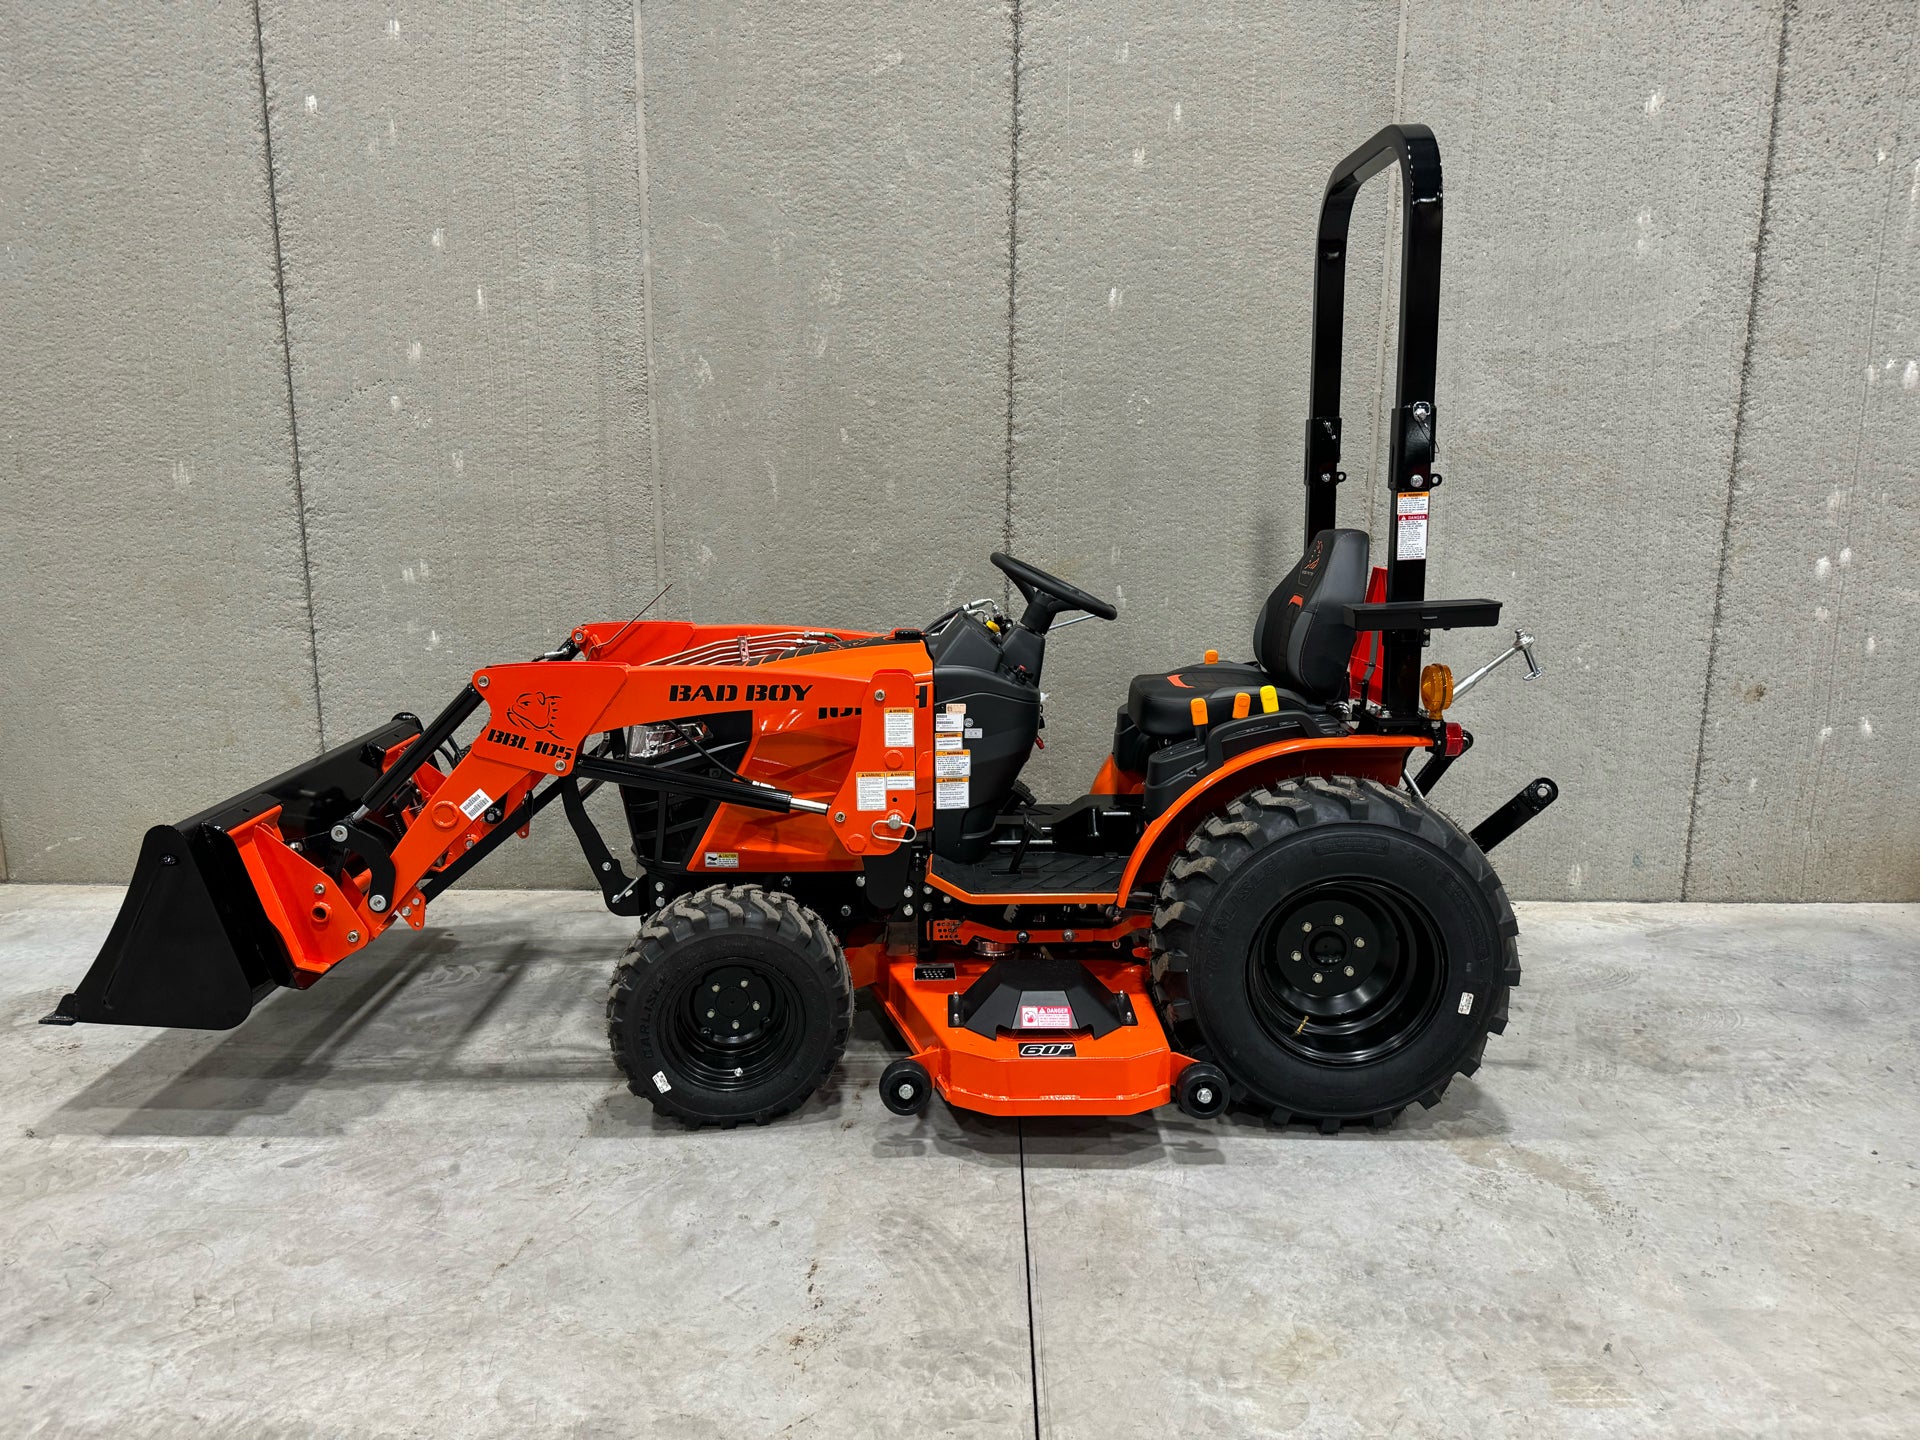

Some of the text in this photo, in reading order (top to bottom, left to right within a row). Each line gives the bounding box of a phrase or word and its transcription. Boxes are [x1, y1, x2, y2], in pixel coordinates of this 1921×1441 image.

[669, 684, 813, 702] BAD BOY
[486, 728, 575, 760] BBL 105
[1020, 1043, 1074, 1056] 60"
